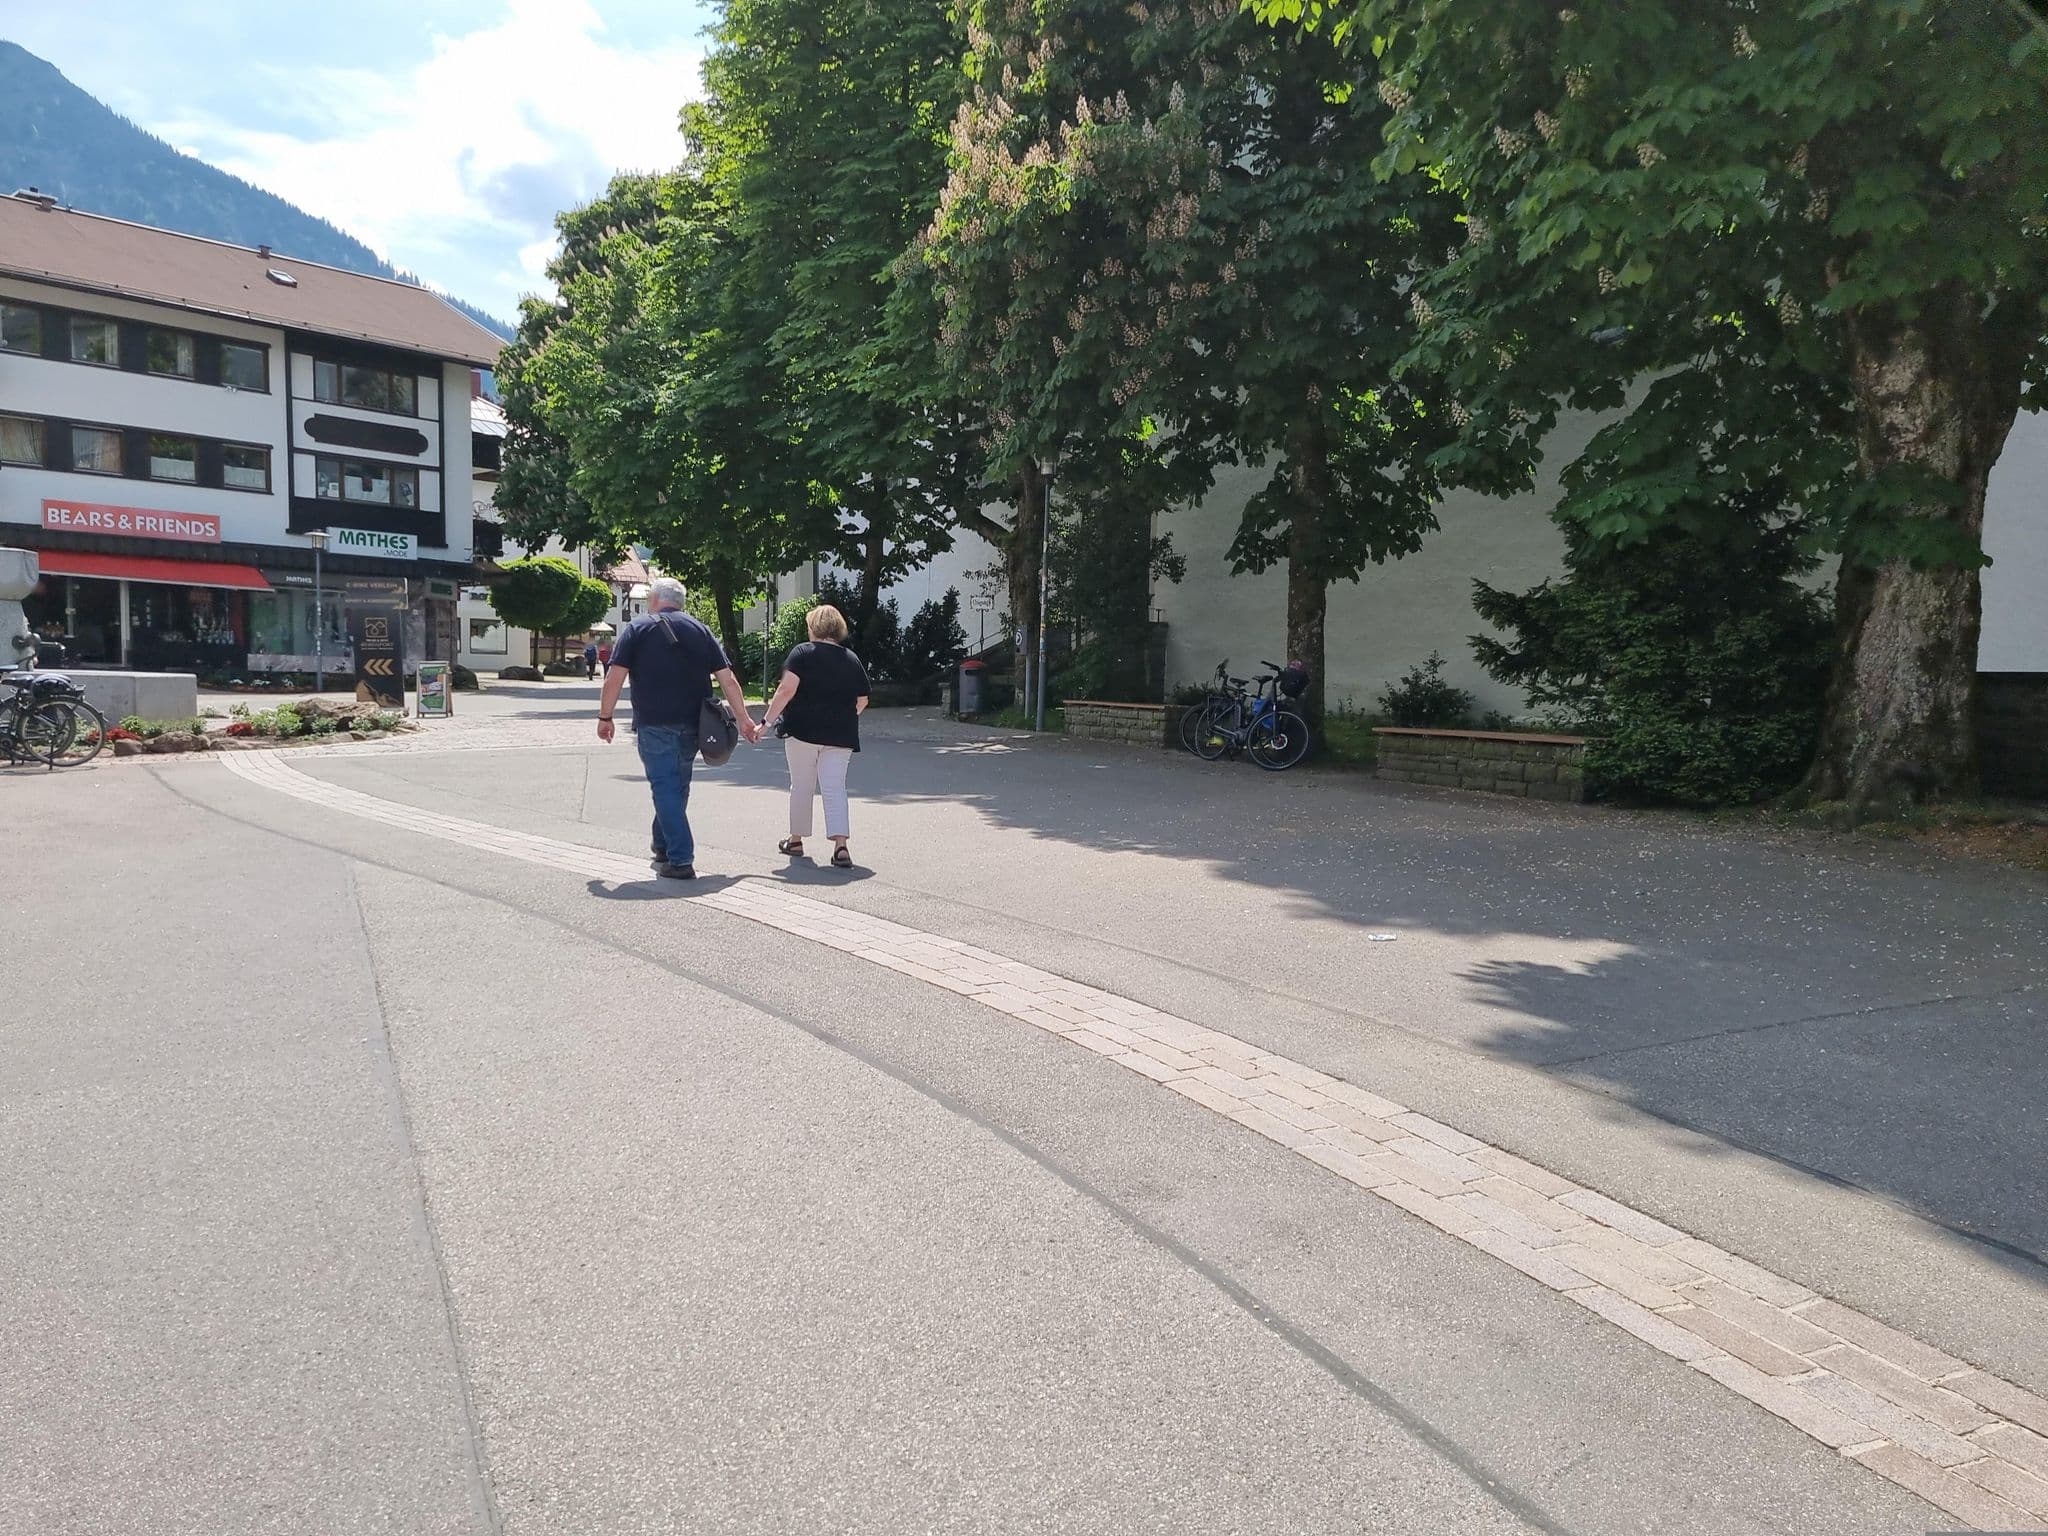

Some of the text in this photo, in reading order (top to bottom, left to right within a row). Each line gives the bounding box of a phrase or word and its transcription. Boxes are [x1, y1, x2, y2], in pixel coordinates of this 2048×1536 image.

[47, 508, 217, 537] BEARS & FRIENDS
[339, 530, 409, 549] MATHES
